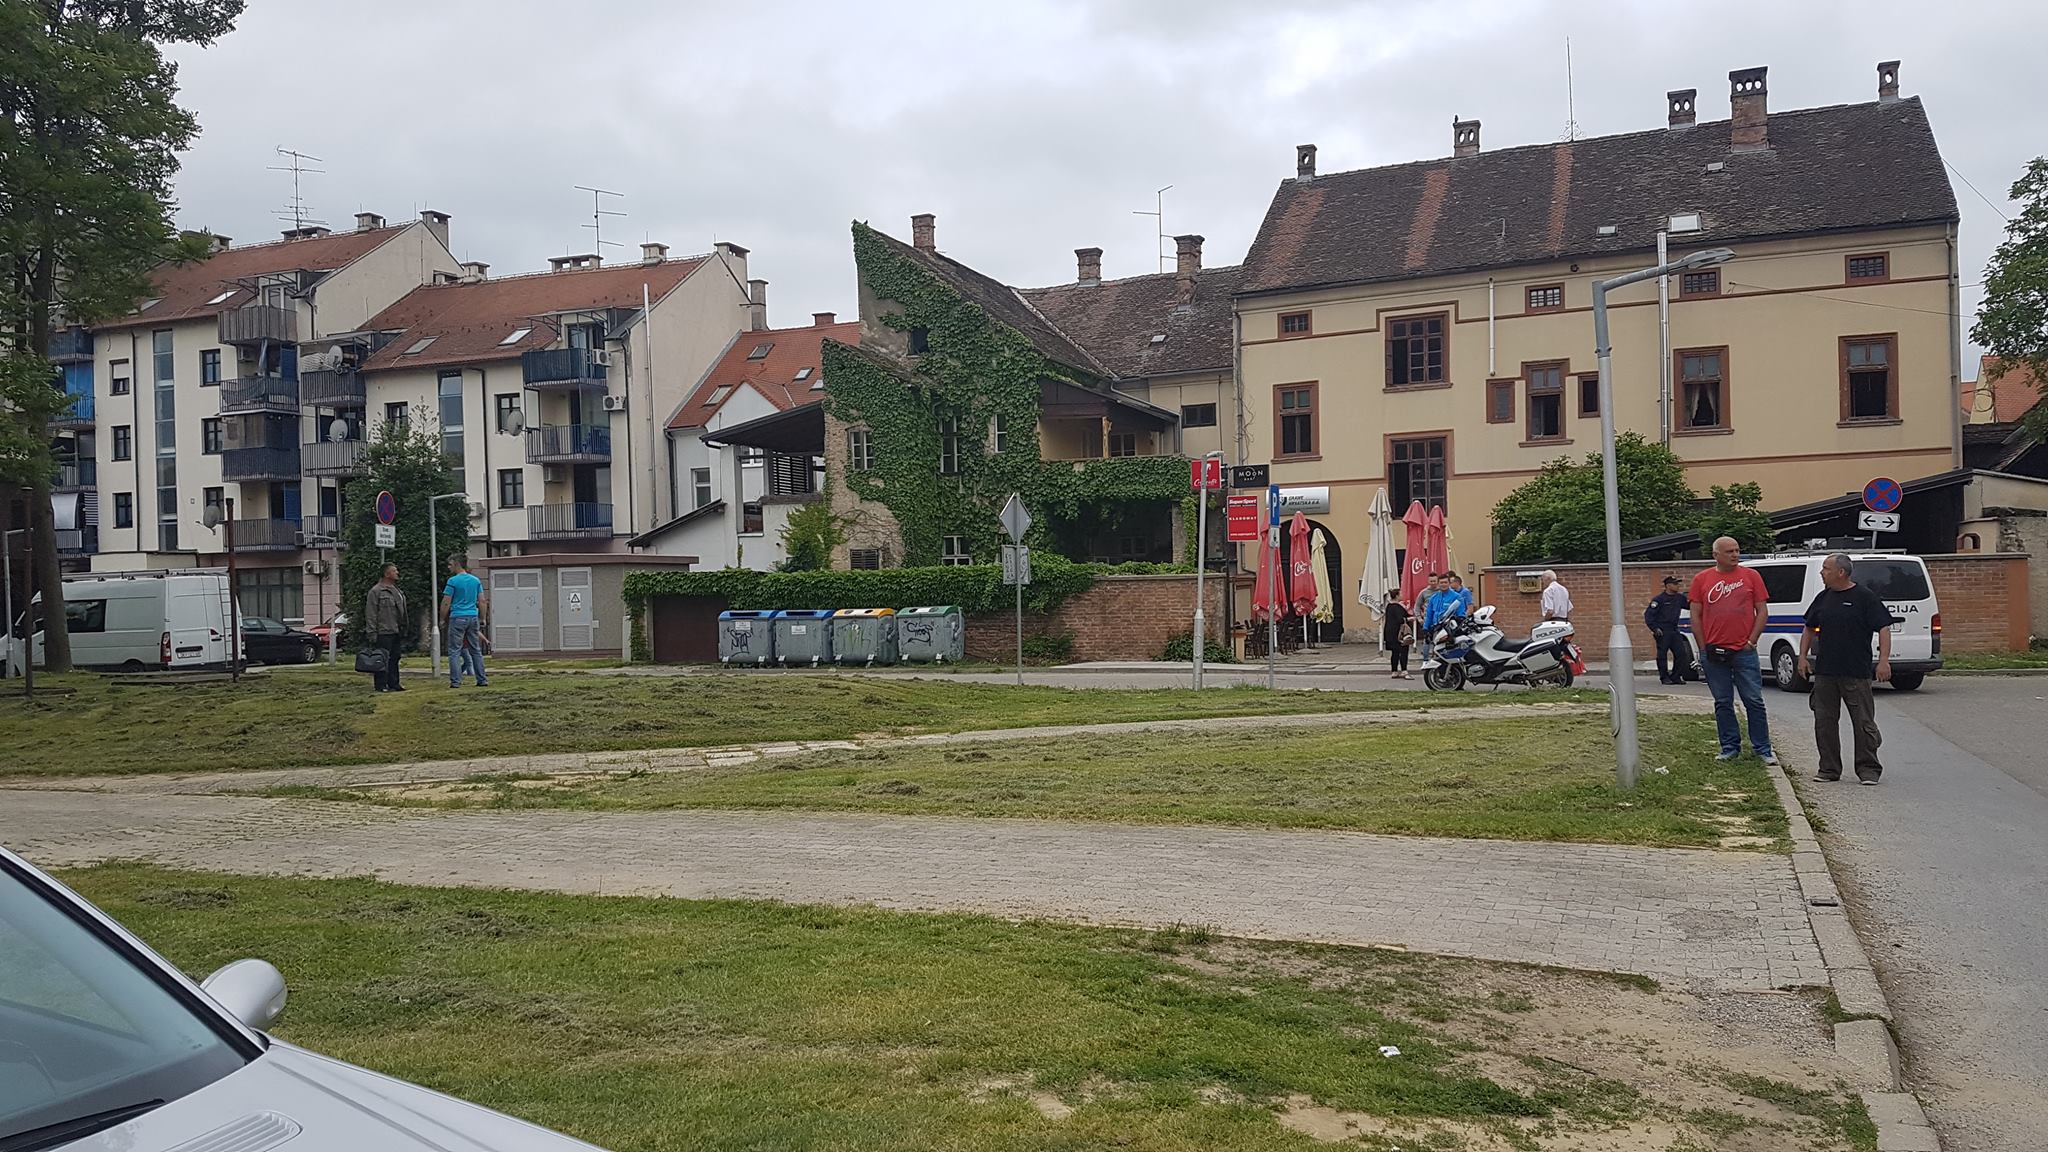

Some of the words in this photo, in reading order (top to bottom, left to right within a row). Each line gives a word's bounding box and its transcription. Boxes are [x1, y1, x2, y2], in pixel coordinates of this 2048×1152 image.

[1708, 579, 1744, 604] Original
[1887, 604, 1919, 613] CIJA
[1536, 627, 1567, 639] POLICIJA
